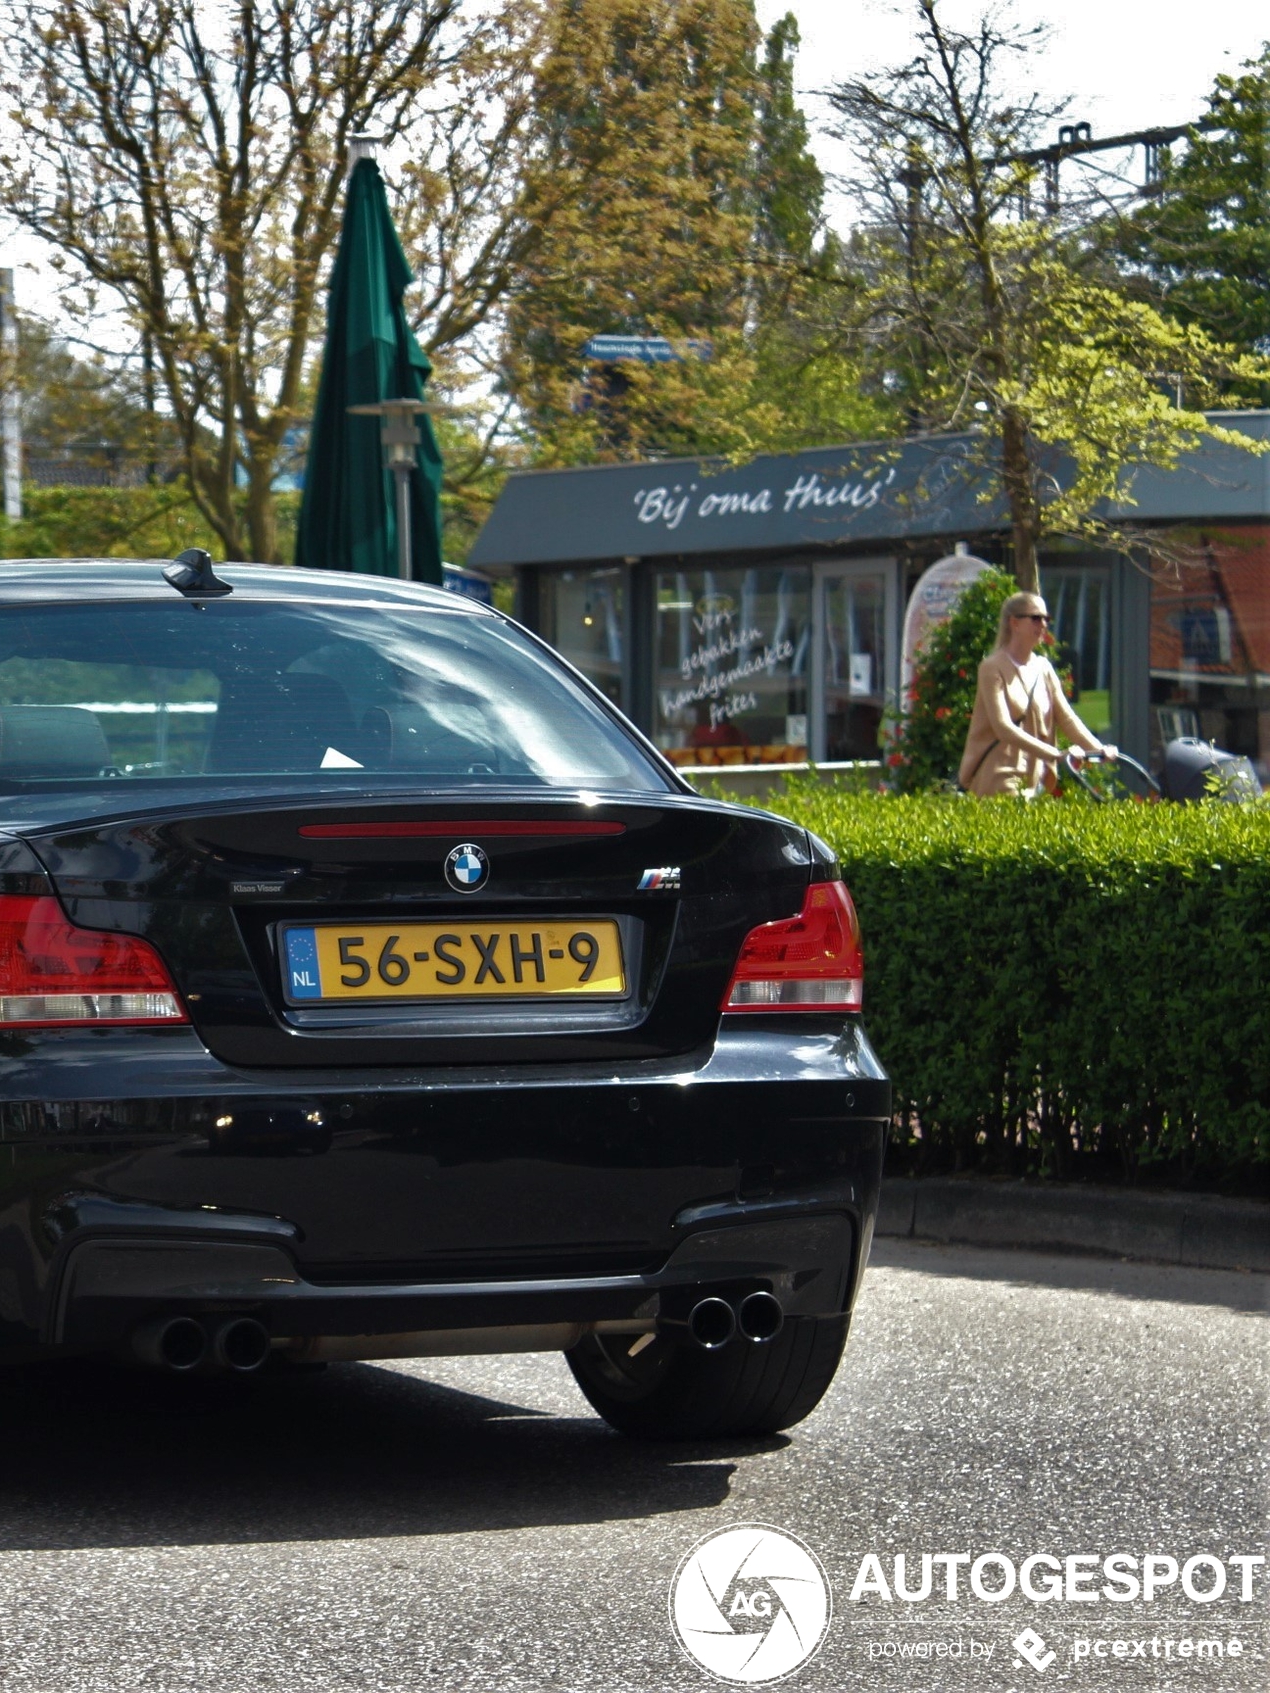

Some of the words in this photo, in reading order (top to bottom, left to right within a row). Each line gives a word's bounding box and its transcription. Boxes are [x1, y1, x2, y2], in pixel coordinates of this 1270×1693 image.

[698, 488, 772, 518] oma
[682, 627, 763, 680] gebakken
[662, 640, 793, 717] handgemaakte
[709, 692, 756, 733] frites
[233, 885, 256, 893] Klaas
[257, 884, 281, 893] Visser
[293, 971, 316, 987] NL
[338, 931, 599, 988] 56-SXH-9
